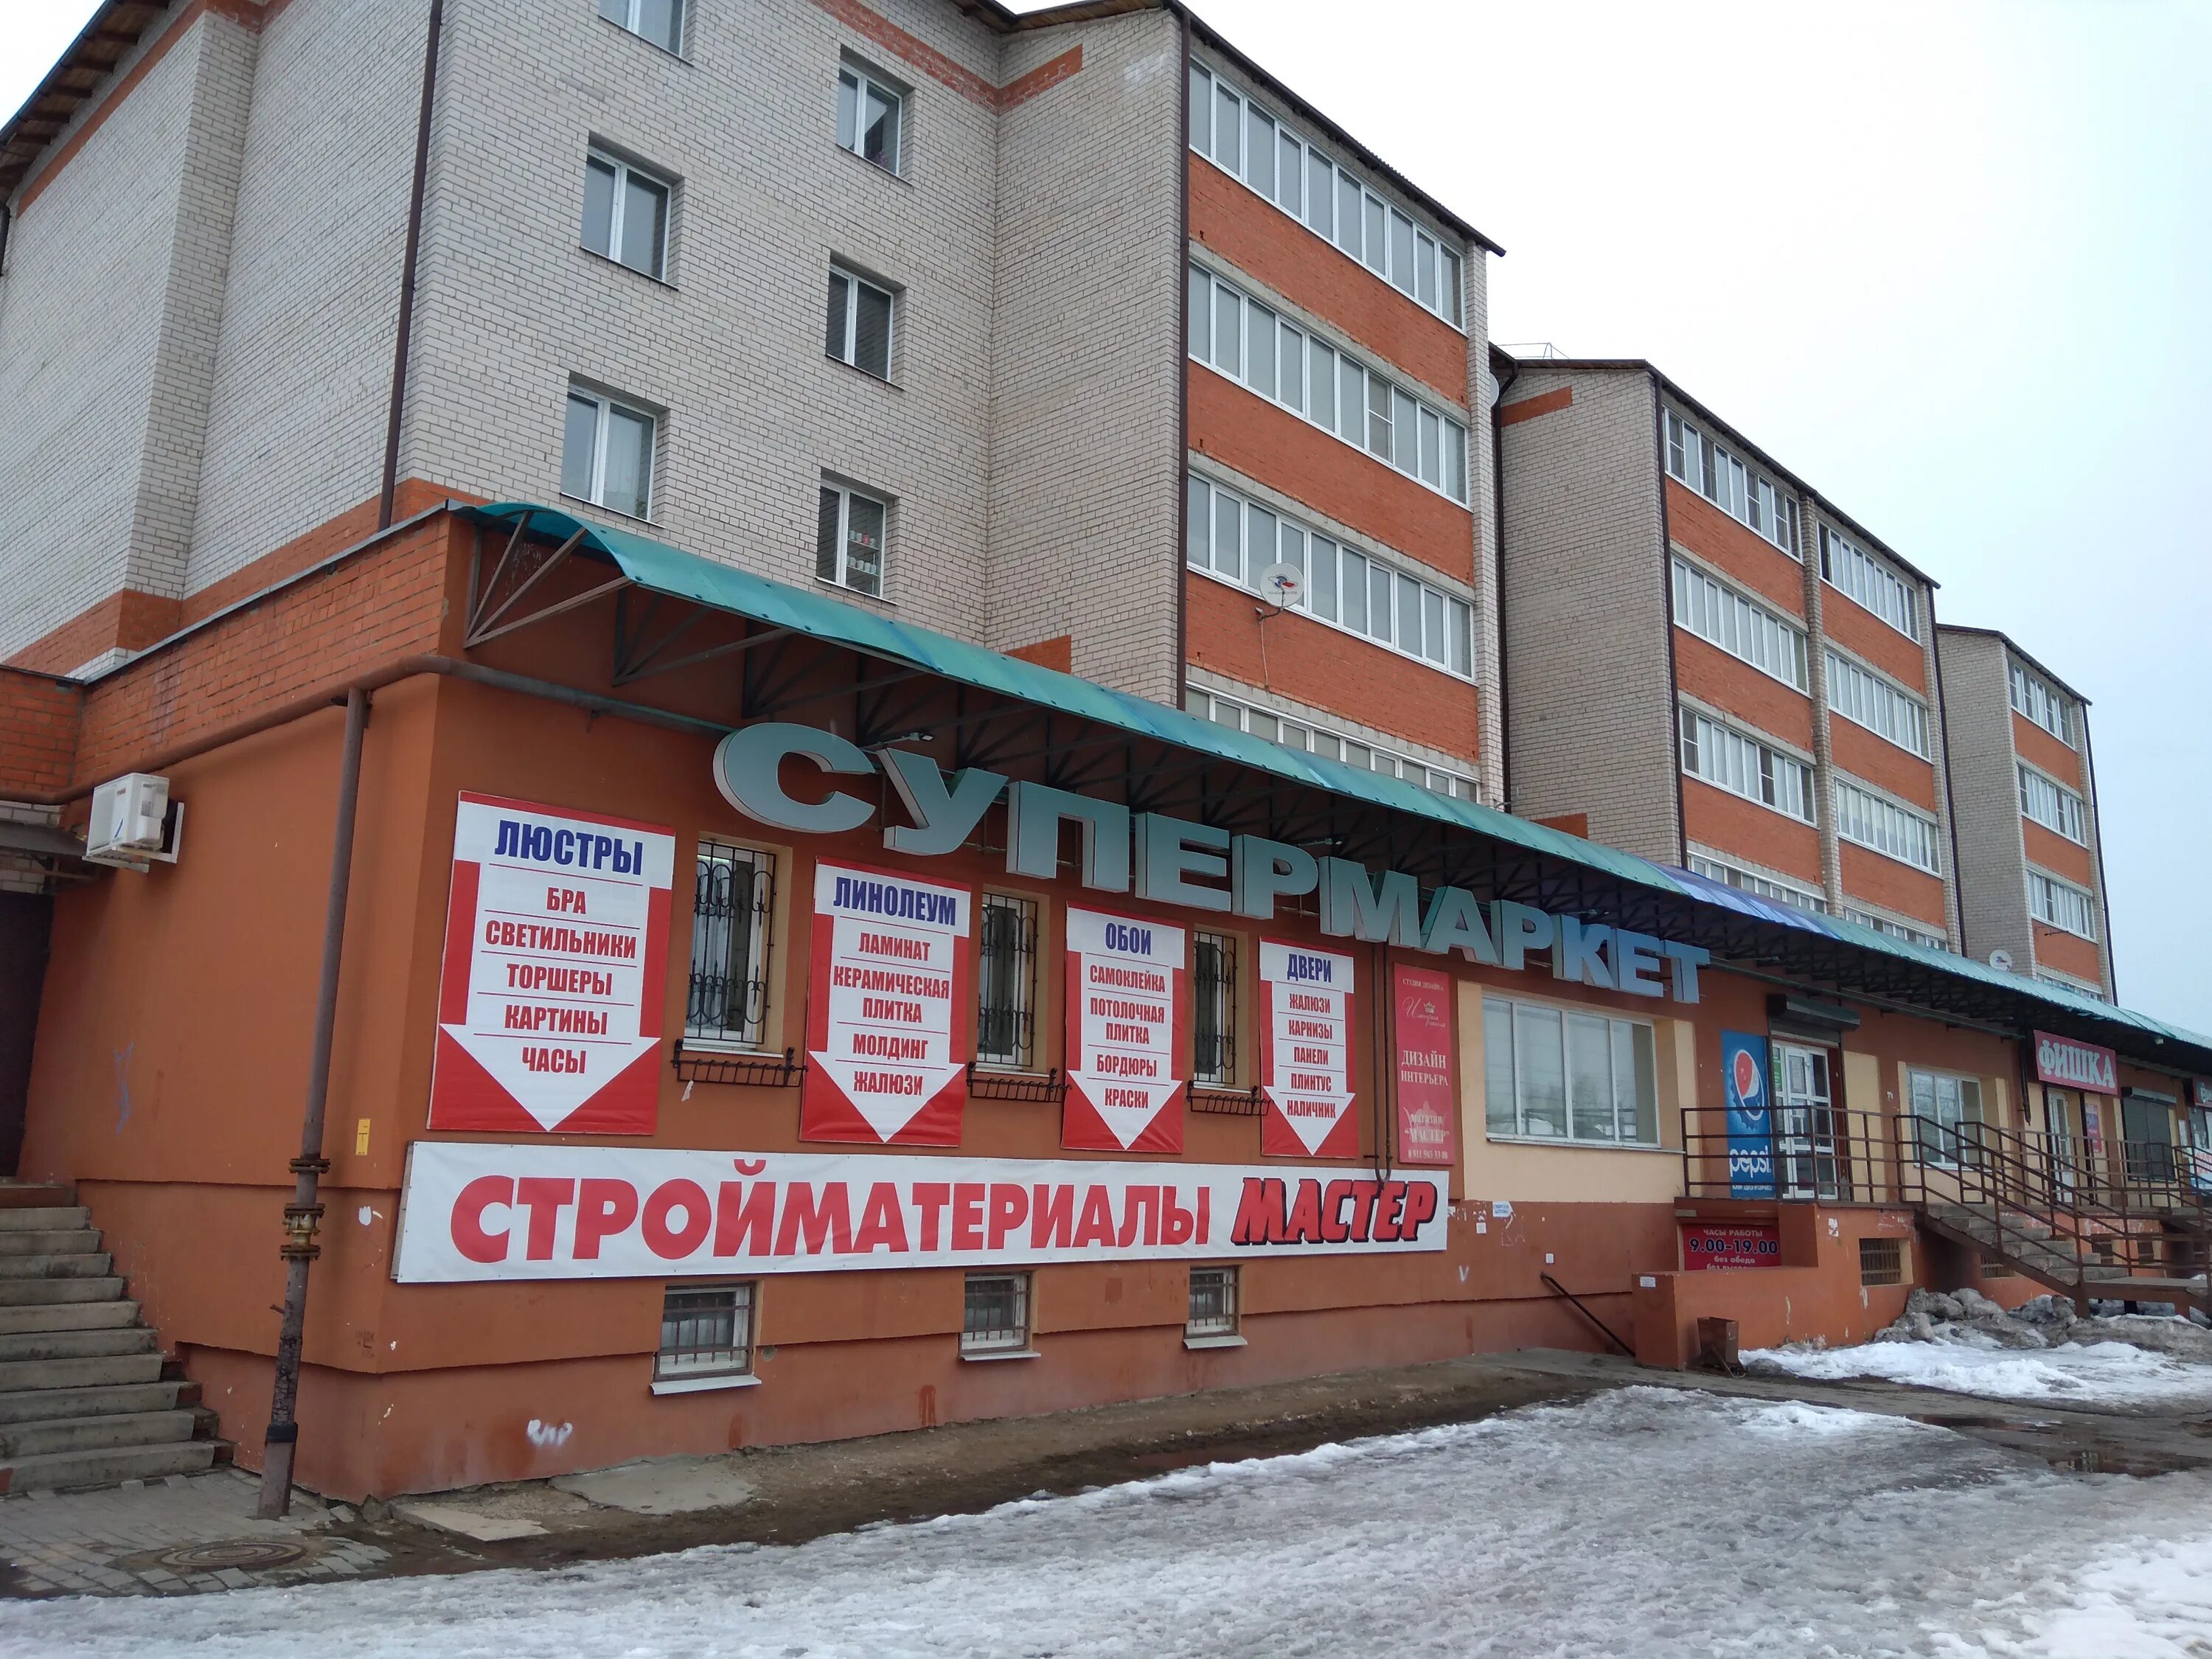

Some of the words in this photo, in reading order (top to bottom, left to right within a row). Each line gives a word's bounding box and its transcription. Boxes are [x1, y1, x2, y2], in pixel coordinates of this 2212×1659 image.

[495, 820, 643, 876] ЛЮСТРЫ
[713, 723, 1709, 1004] СУПЕРМАРКЕТ
[546, 887, 587, 914] БРА
[833, 877, 956, 926] ЛИНОЛЕУМ
[484, 920, 636, 959] СВЕТИЛЬНИКИ
[858, 933, 931, 961] ЛАМИНАТ
[1105, 922, 1151, 956] ОБОИ
[506, 963, 612, 996] ТОРШЕРЫ
[1090, 964, 1166, 993] САМОКЛЕЙКА
[1287, 953, 1332, 983] ДВЕРИ
[833, 966, 950, 1000] КЕРАМИЧЕСКАЯ
[863, 998, 922, 1023] ПЛИТКА
[1090, 997, 1165, 1023] ПОТОЛОЧНАЯ
[1289, 993, 1330, 1014] ЖАЛЮЗИ
[504, 1005, 608, 1035] КАРТИНЫ
[1288, 1019, 1332, 1040] КАРНИЗЫ
[1105, 1022, 1150, 1045] ПЛИТКА
[852, 1034, 928, 1060] МОЛДИНГ
[1293, 1046, 1329, 1065] ПАНЕЛИ
[1402, 1050, 1446, 1069] ДИЗАЙН
[521, 1047, 586, 1074] ЧАСЫ
[1096, 1054, 1157, 1078] БОРДЮРЫ
[2039, 1040, 2115, 1088] ФИШКА
[853, 1071, 923, 1096] ЖАЛЮЗИ
[1290, 1073, 1332, 1092] ПЛИНТУС
[1401, 1070, 1448, 1086] ИНТЕРЬЕРА
[1105, 1088, 1149, 1109] КРАСКИ
[1287, 1099, 1336, 1119] НАЛИЧНИК
[1729, 1145, 1770, 1178] pepsi
[451, 1159, 1209, 1263] СТРОЙМАТЕРИАЛЫ
[1231, 1177, 1438, 1245] МАСТЕР
[1729, 1229, 1763, 1237] РАБОТЫ
[1689, 1238, 1778, 1255] 9.00-19.00
[1730, 1256, 1755, 1265] обеда
